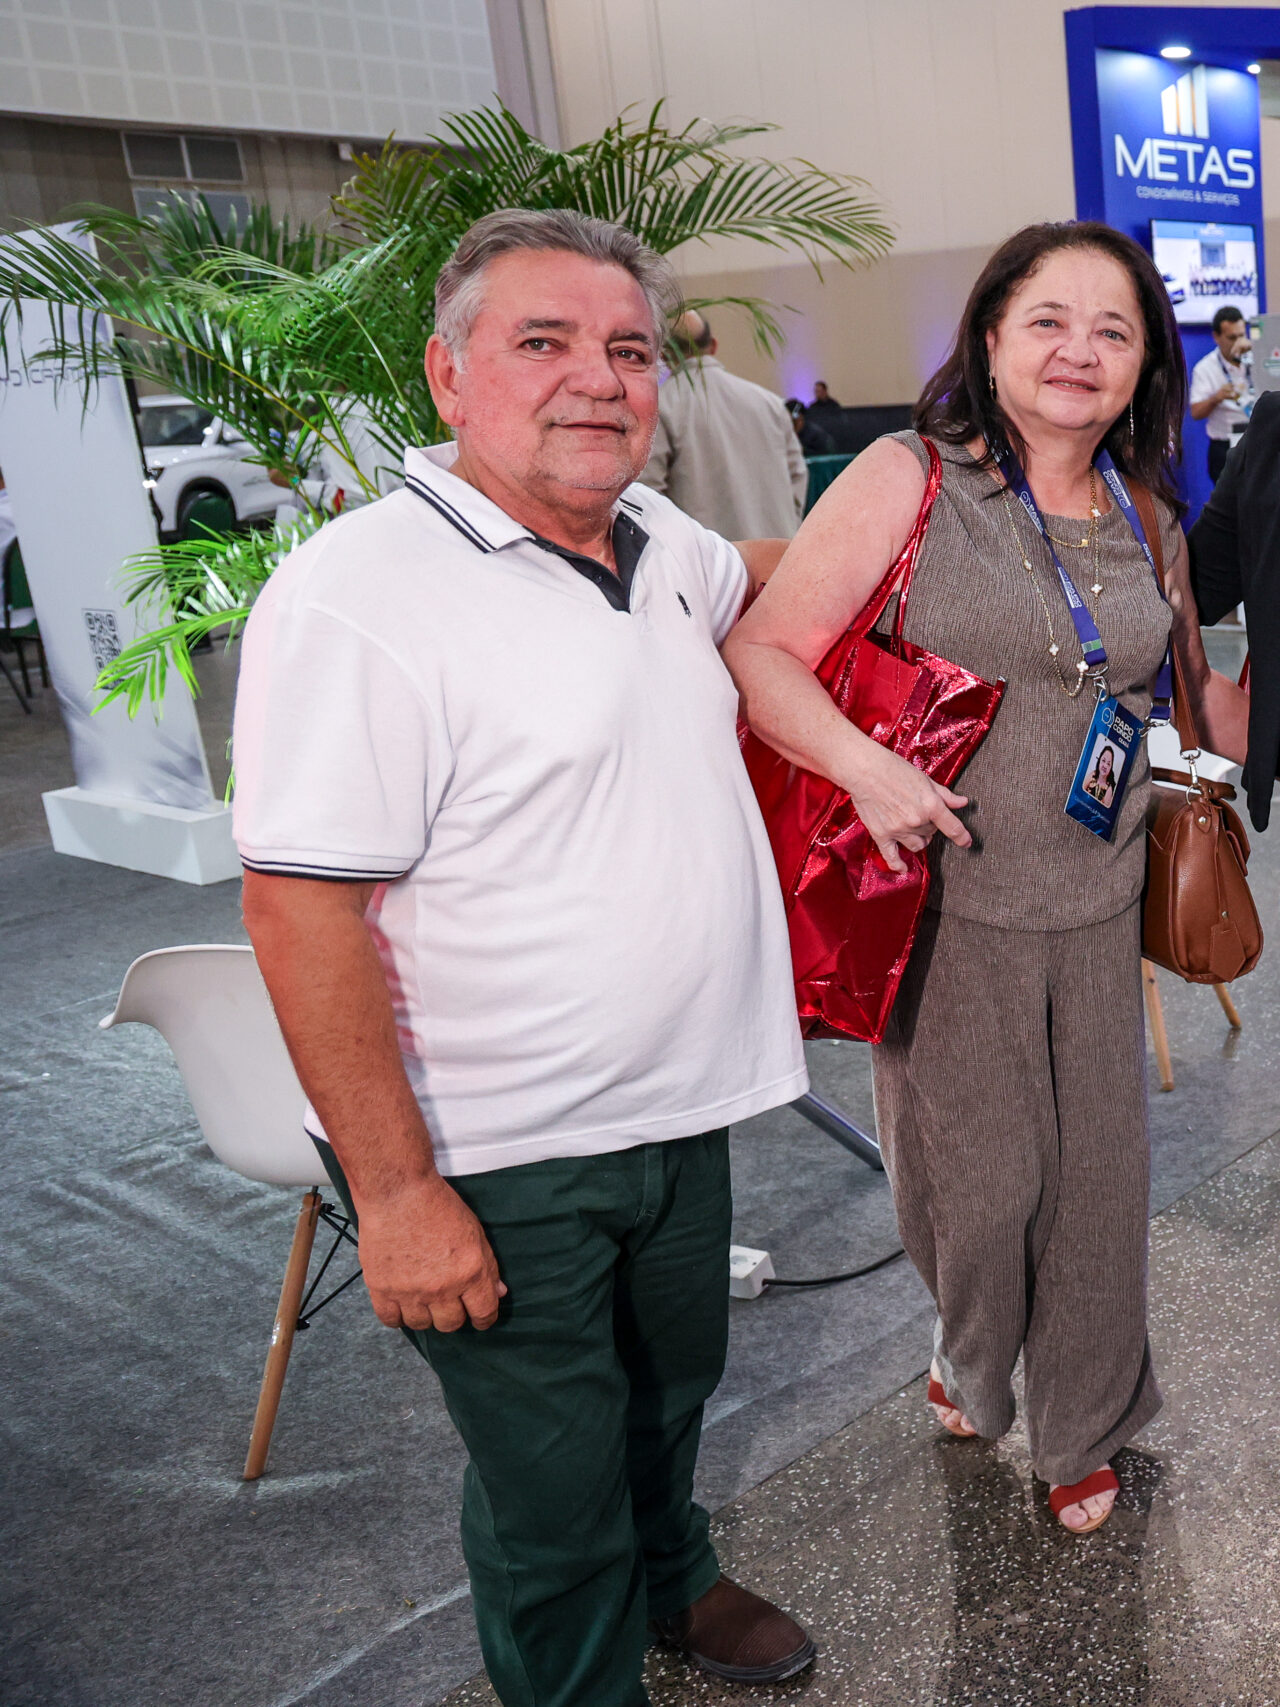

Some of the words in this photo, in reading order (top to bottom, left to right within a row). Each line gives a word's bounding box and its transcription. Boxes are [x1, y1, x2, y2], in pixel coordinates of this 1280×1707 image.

[1114, 133, 1255, 189] METAS
[1112, 723, 1132, 743] CONDO
[1114, 716, 1134, 737] PAPO
